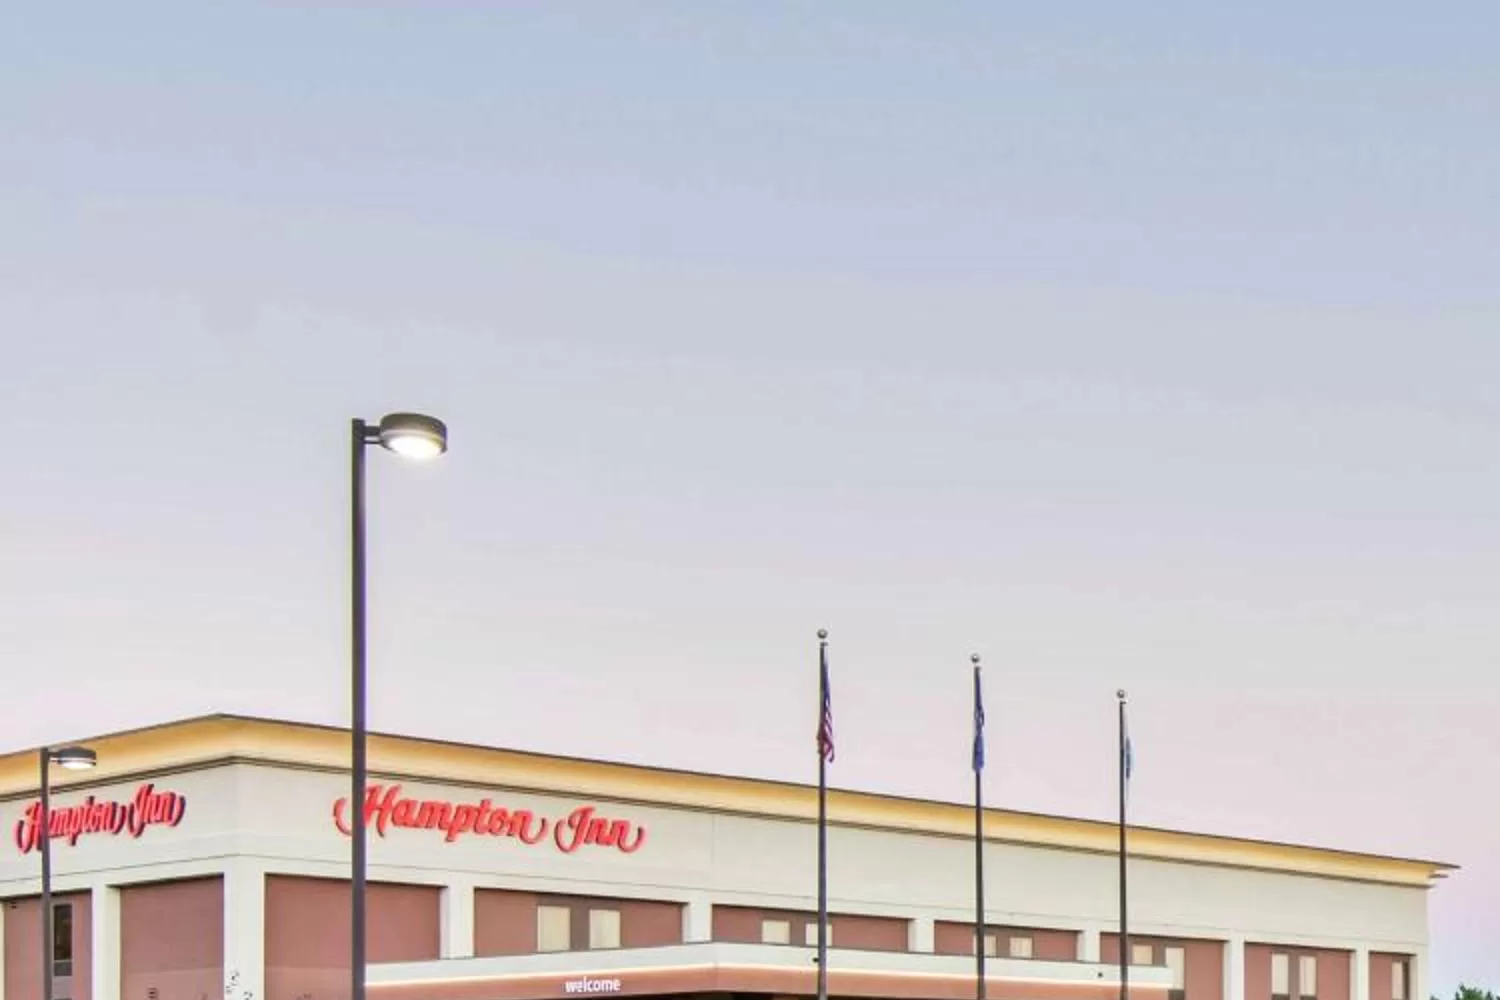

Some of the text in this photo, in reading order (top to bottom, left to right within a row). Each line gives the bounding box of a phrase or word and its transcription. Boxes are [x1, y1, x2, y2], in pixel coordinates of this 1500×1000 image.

[128, 783, 187, 838] Inn
[333, 784, 645, 853] Hampton Inn
[565, 976, 621, 993] welcome
